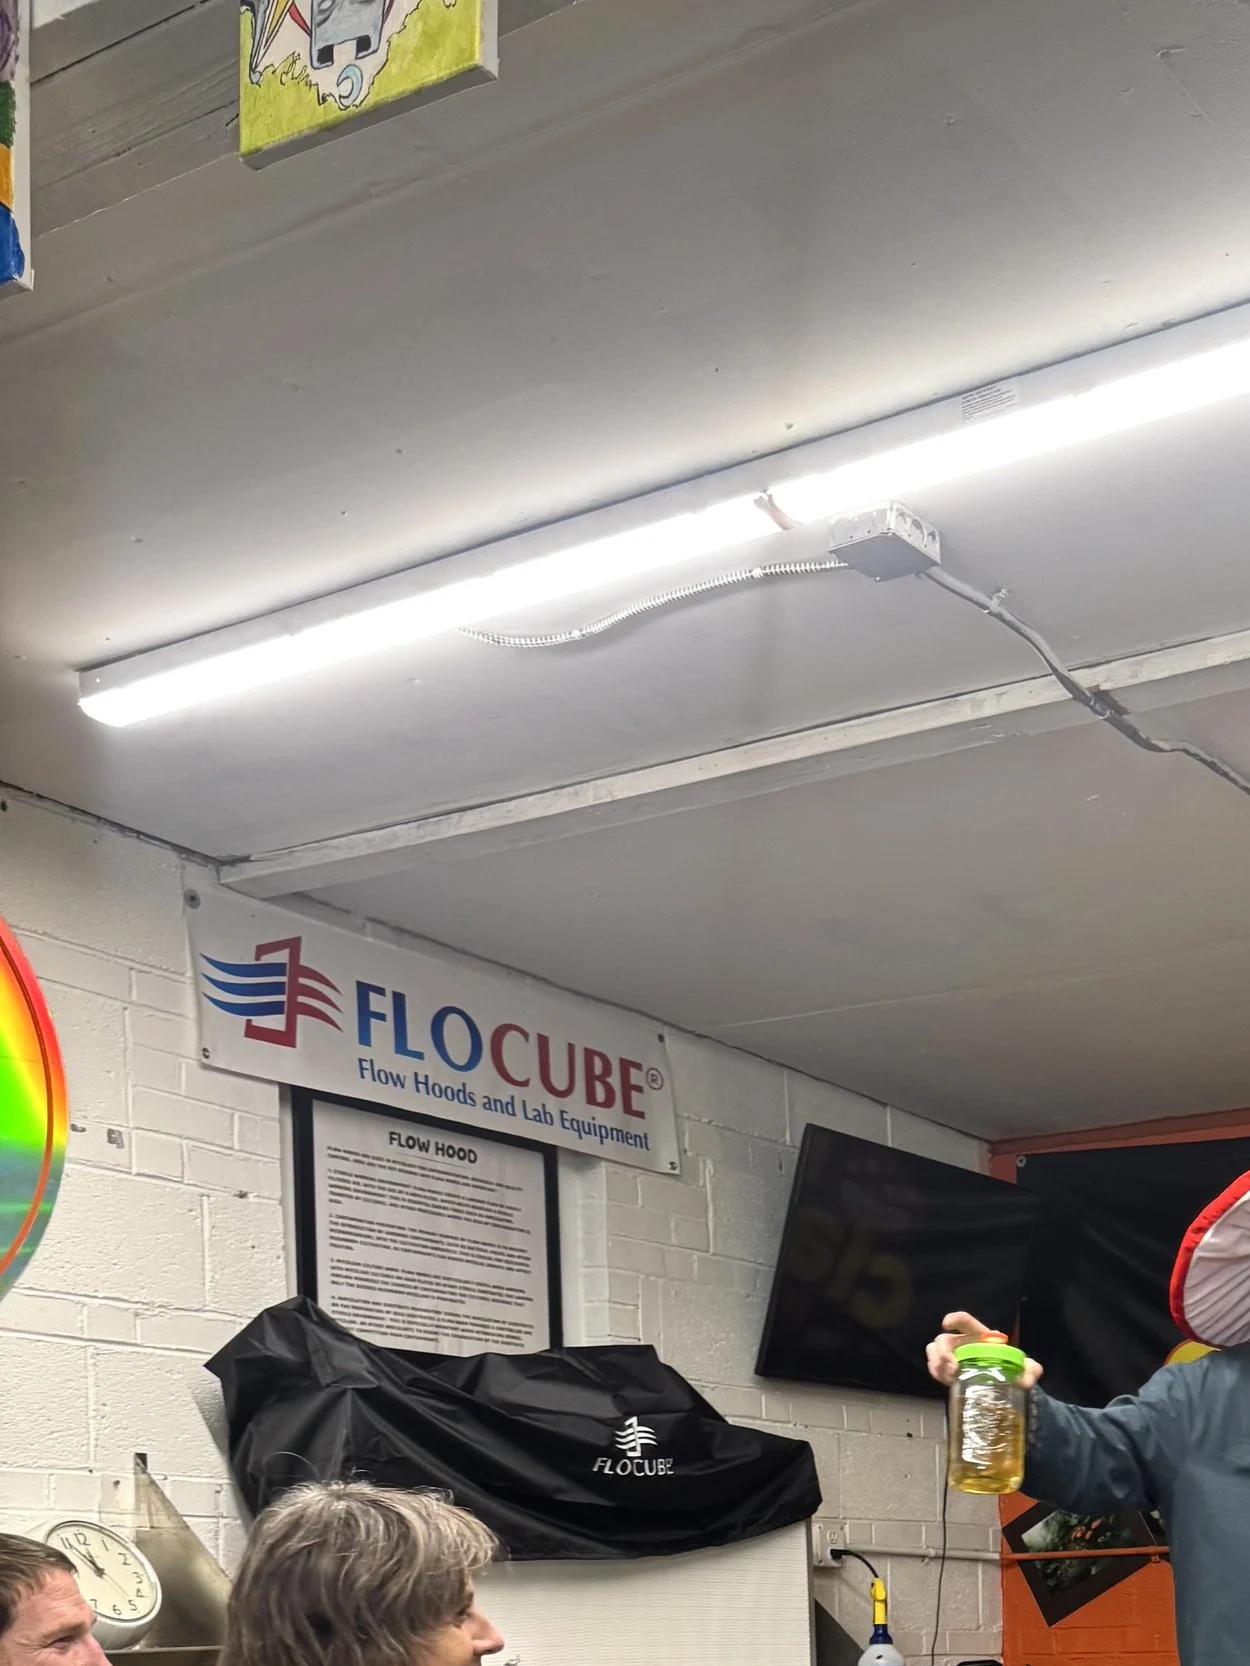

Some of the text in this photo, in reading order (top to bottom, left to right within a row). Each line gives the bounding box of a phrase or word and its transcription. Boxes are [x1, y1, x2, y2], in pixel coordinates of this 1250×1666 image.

[358, 1057, 650, 1151] Flow Hoods and Lab Equipment
[389, 1131, 478, 1164] FLOW HOOD
[592, 1457, 675, 1476] FLOCUBE
